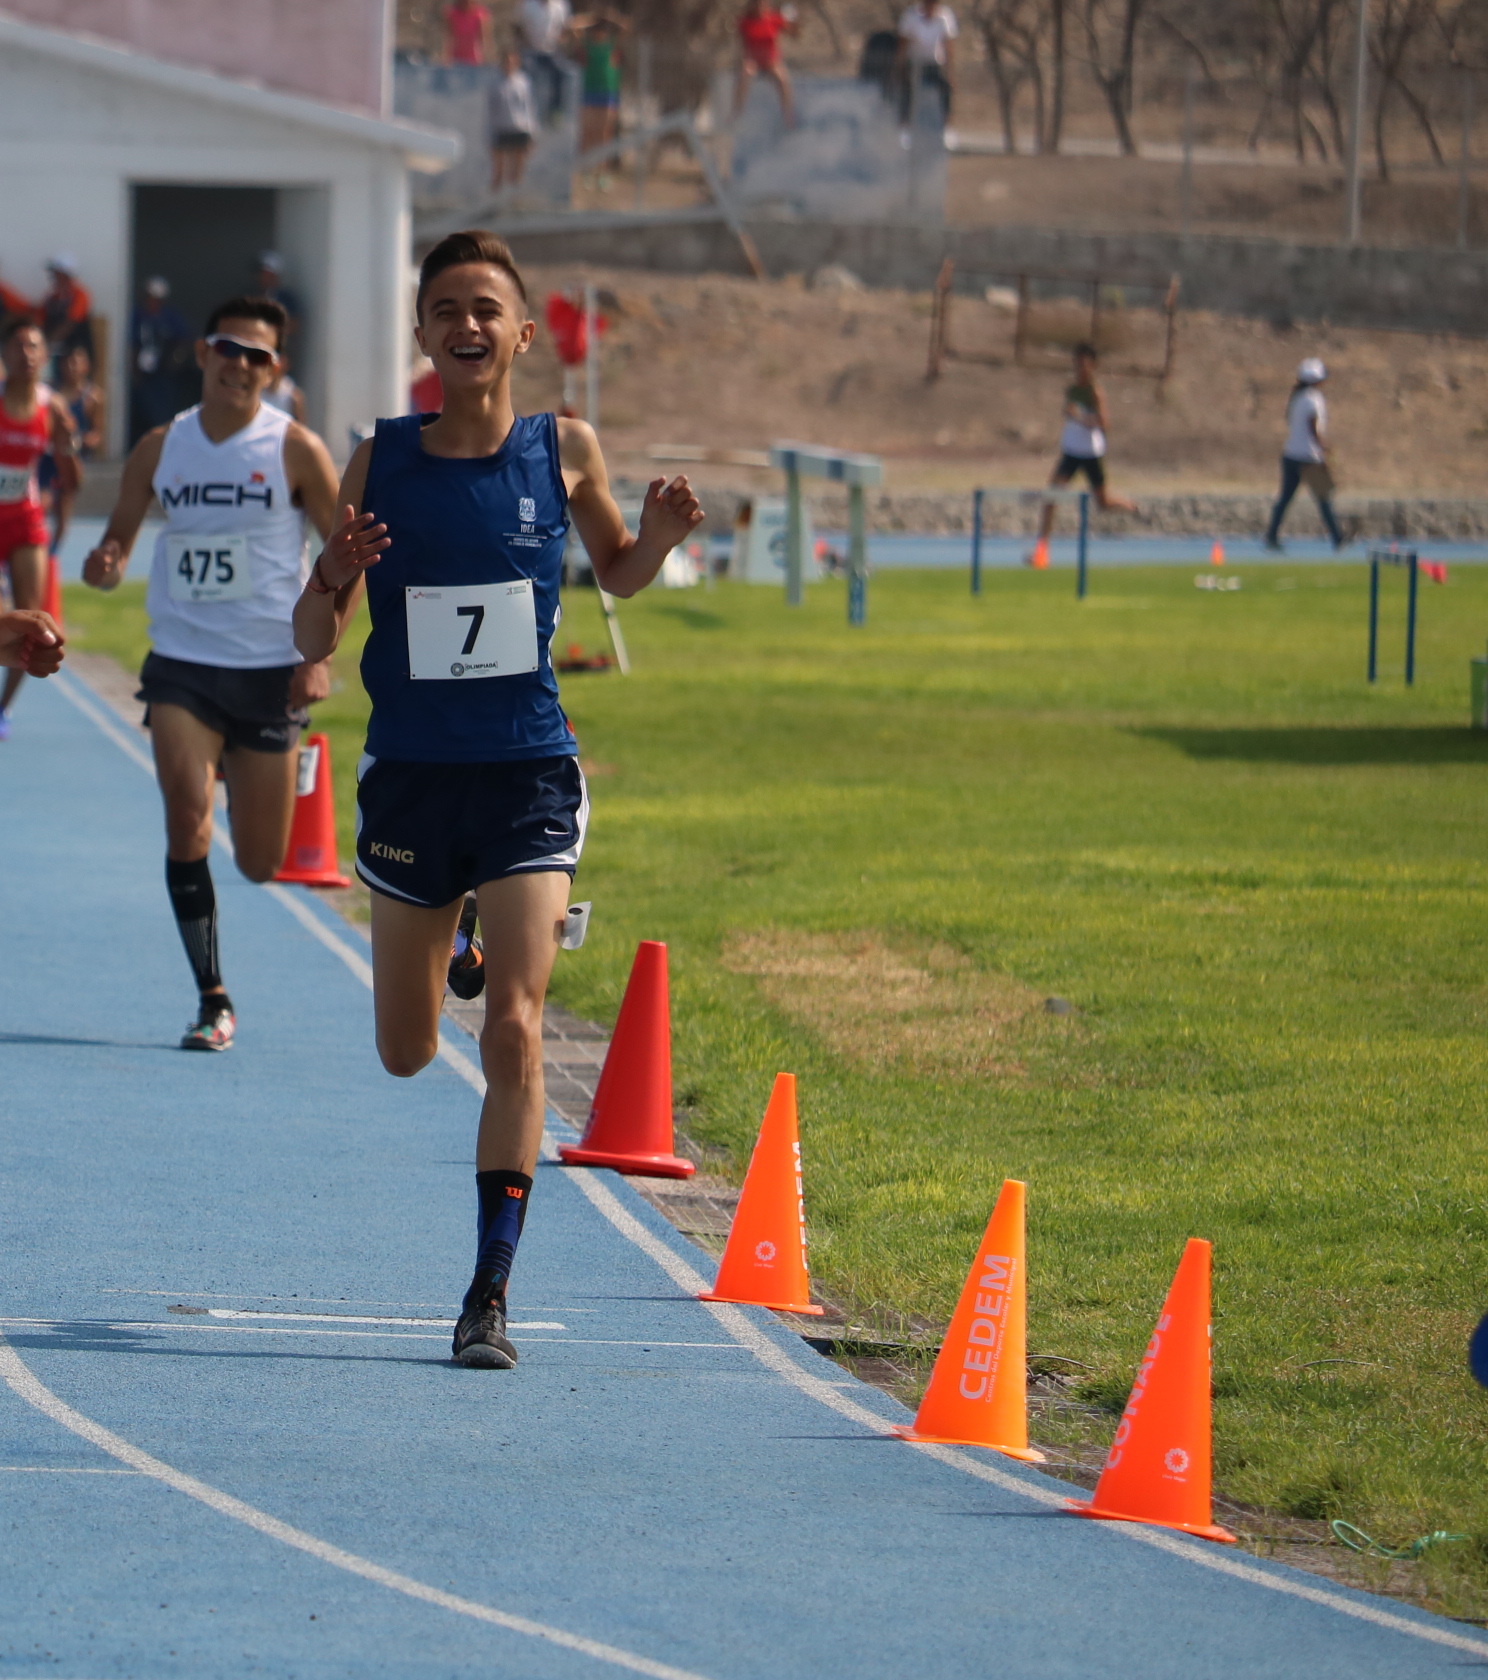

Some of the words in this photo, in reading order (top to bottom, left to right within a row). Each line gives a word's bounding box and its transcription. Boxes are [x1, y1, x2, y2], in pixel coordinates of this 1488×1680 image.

[161, 483, 272, 510] MICH
[177, 549, 234, 584] 475
[456, 605, 485, 655] 7
[370, 841, 415, 864] KING
[1005, 1257, 1017, 1294] Municipal
[959, 1254, 1010, 1400] CEDEM
